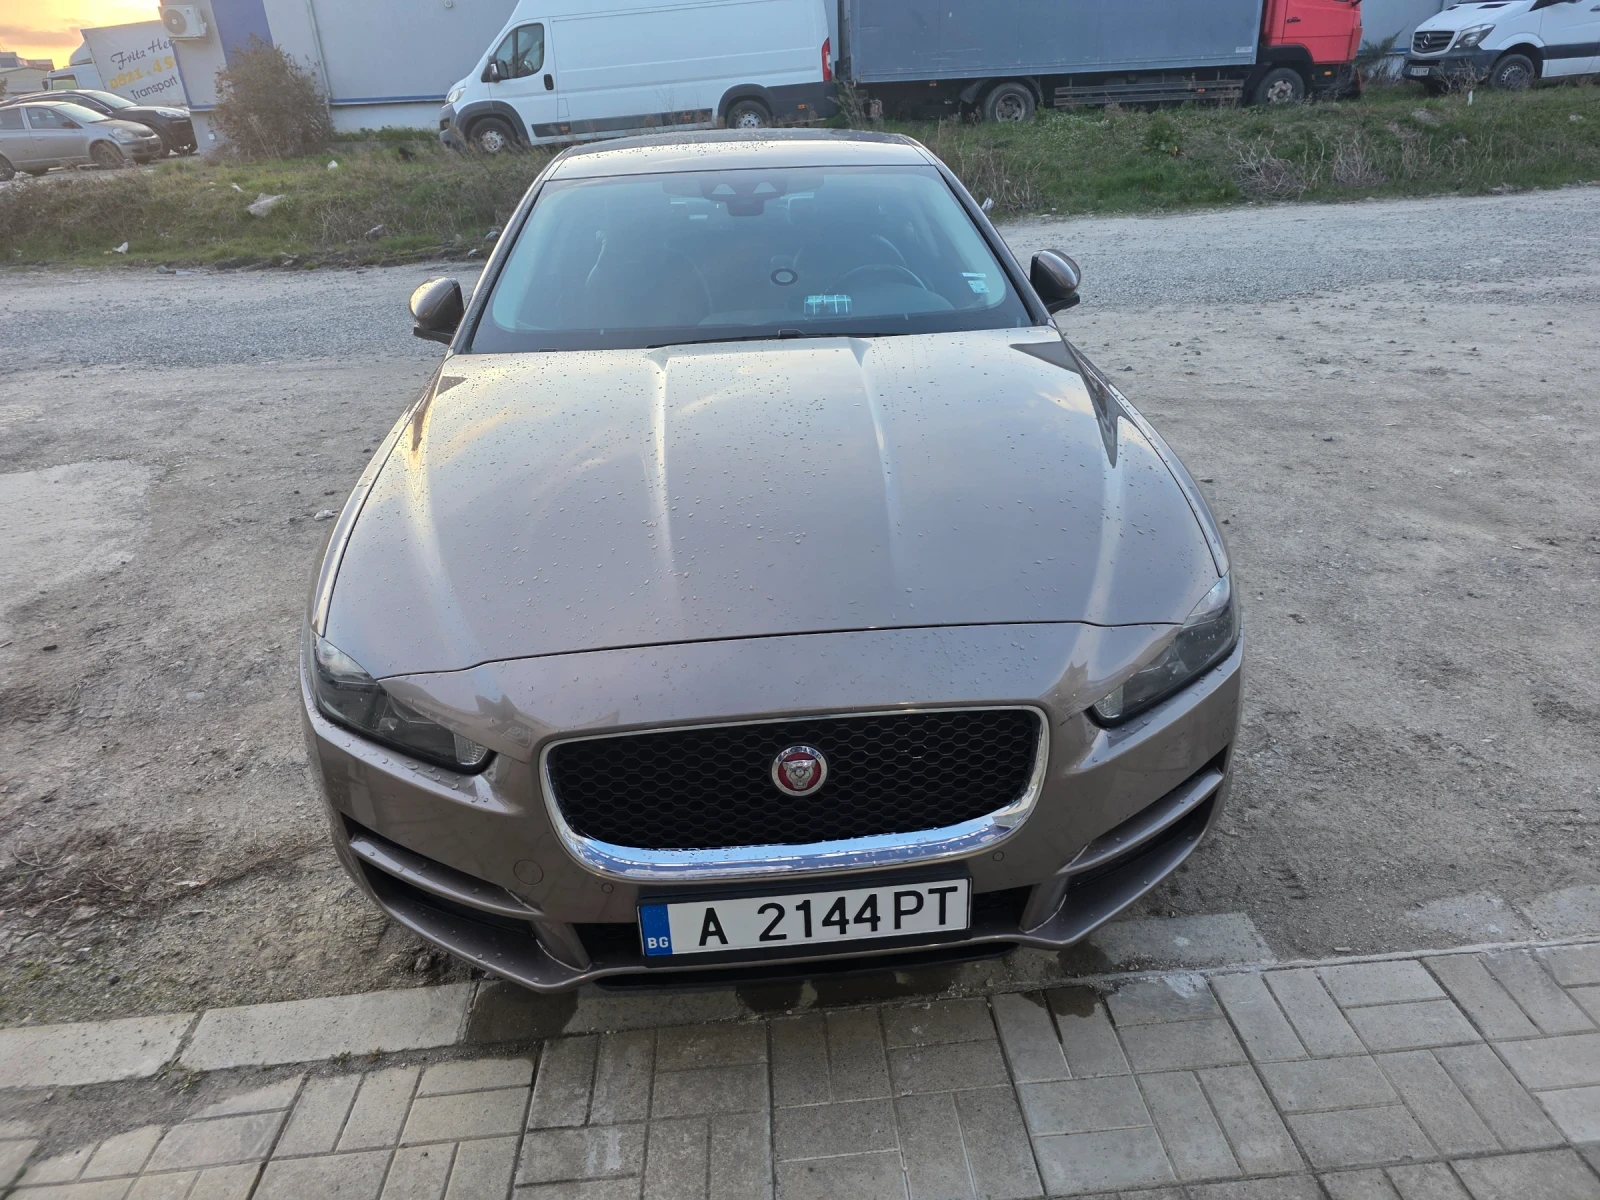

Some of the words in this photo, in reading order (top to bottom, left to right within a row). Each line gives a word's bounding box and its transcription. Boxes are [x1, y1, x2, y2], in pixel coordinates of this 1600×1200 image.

[110, 50, 146, 70] Fritz
[130, 75, 178, 100] Transport
[647, 936, 669, 949] BG
